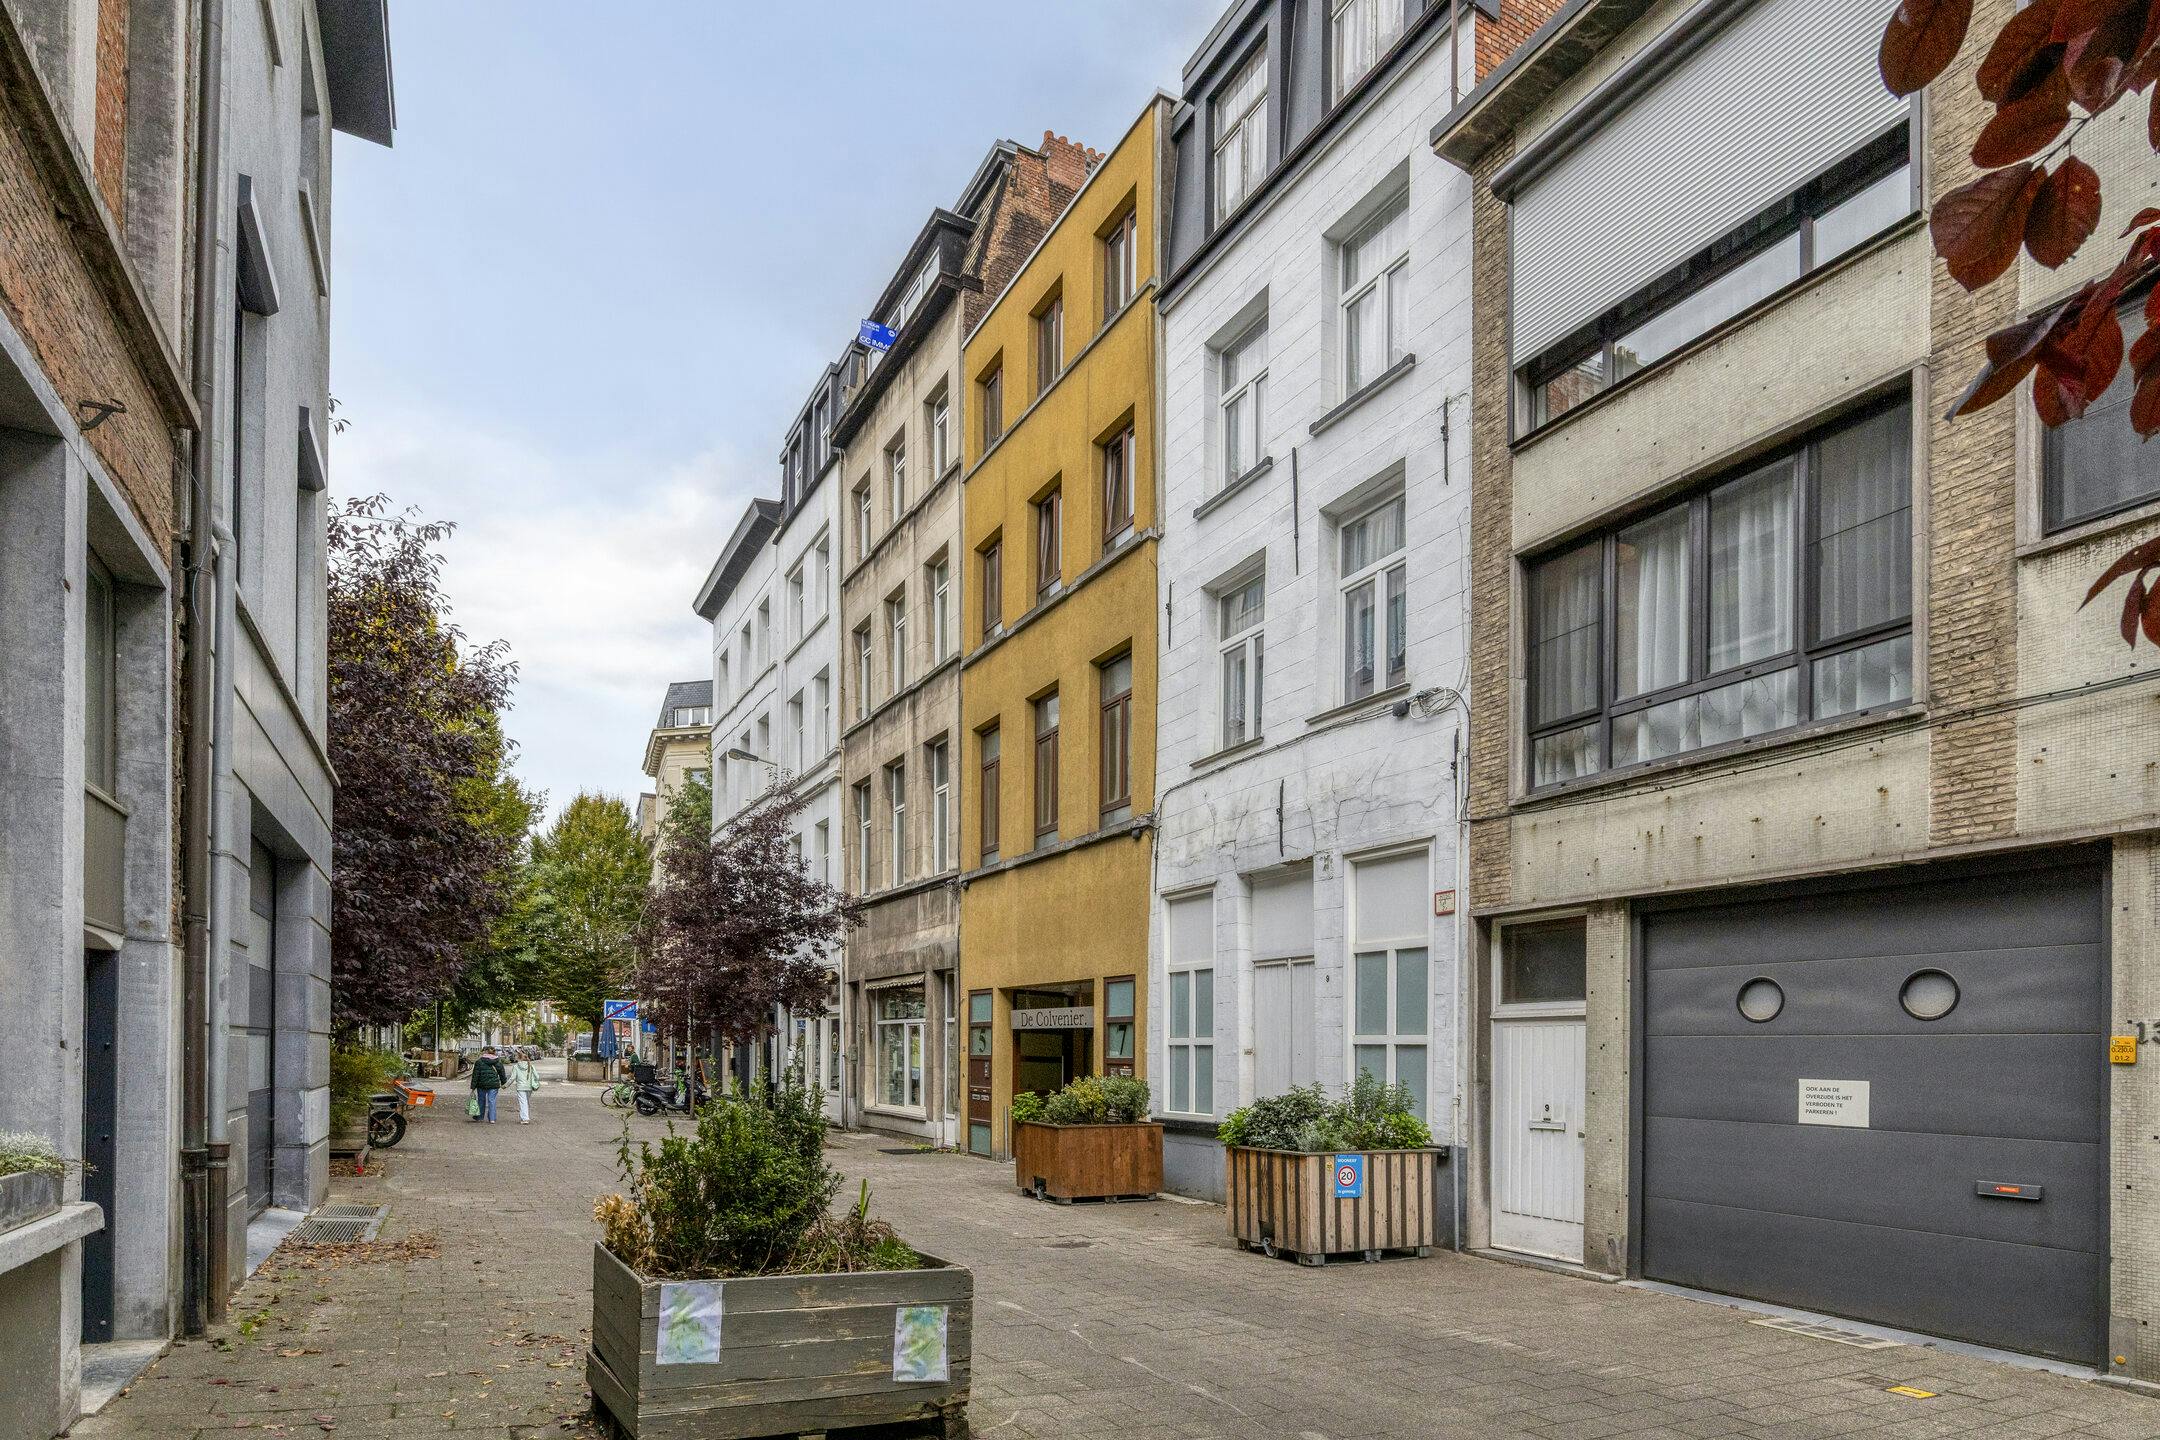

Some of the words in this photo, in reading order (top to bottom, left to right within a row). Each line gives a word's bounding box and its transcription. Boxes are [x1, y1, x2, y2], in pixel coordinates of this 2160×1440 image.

[1326, 975, 1330, 983] 9
[1021, 1012, 1034, 1027] De
[979, 1028, 986, 1053] 5
[1117, 1024, 1127, 1056] 7
[1544, 1104, 1550, 1112] 9
[1341, 1171, 1353, 1181] 20
